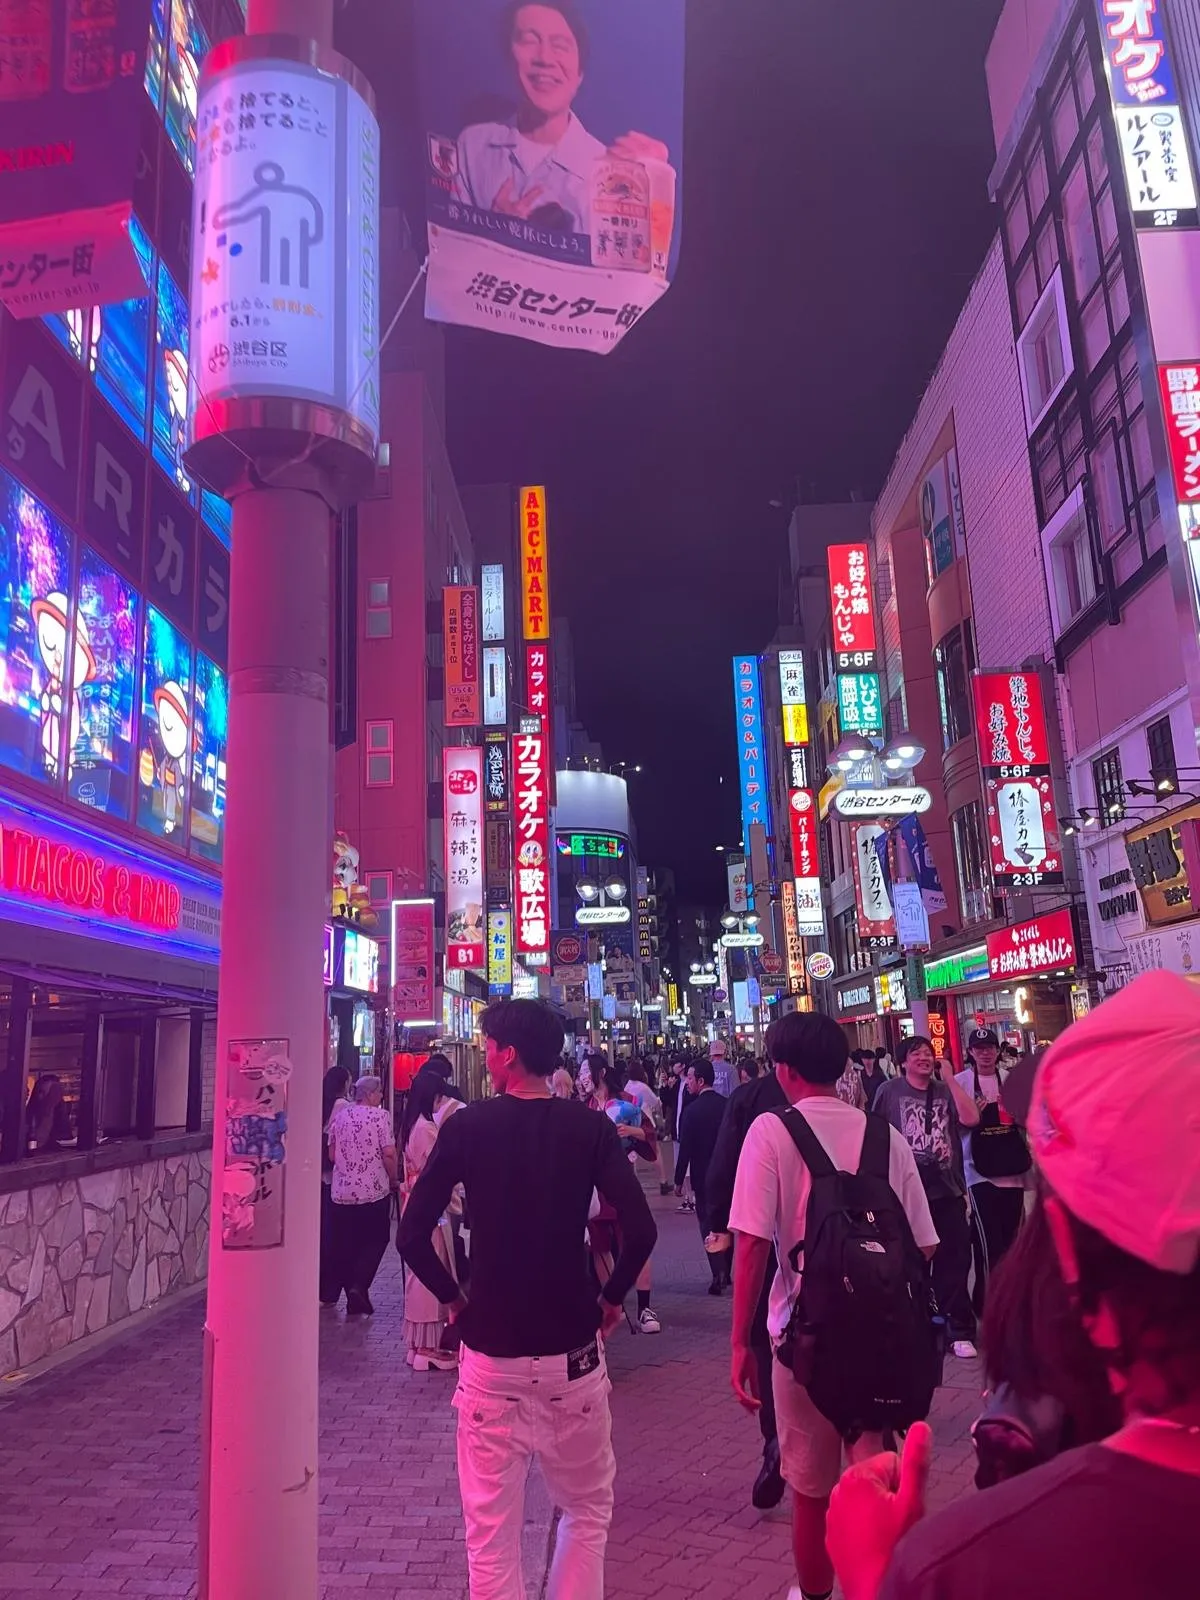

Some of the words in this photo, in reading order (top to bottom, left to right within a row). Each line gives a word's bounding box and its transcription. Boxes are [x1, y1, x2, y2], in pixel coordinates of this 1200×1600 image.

[1127, 115, 1161, 203] ルノアール
[1159, 130, 1179, 183] 喫茶室
[1153, 210, 1178, 226] 2F
[465, 271, 643, 330] 渋谷センター街
[232, 340, 287, 357] 渋谷区
[848, 550, 869, 614] お好み焼
[833, 583, 855, 647] もんじゃ
[531, 651, 546, 709] カラオ
[786, 669, 799, 697] 麻雀
[841, 677, 860, 722] 無呼吸
[860, 675, 878, 722] いびき
[990, 703, 1012, 763] お好み焼
[1010, 676, 1036, 762] 築地もんじゃ
[518, 735, 544, 838] カラオケ
[840, 792, 926, 809] 渋谷センター街
[451, 811, 469, 886] 麻辣湯
[798, 817, 812, 875] バーガーキング
[14, 829, 105, 909] TACOS
[113, 866, 131, 916] &
[138, 873, 181, 931] BAR
[519, 868, 547, 947] 歌広場
[493, 932, 506, 961] 松屋
[811, 962, 831, 975] KING
